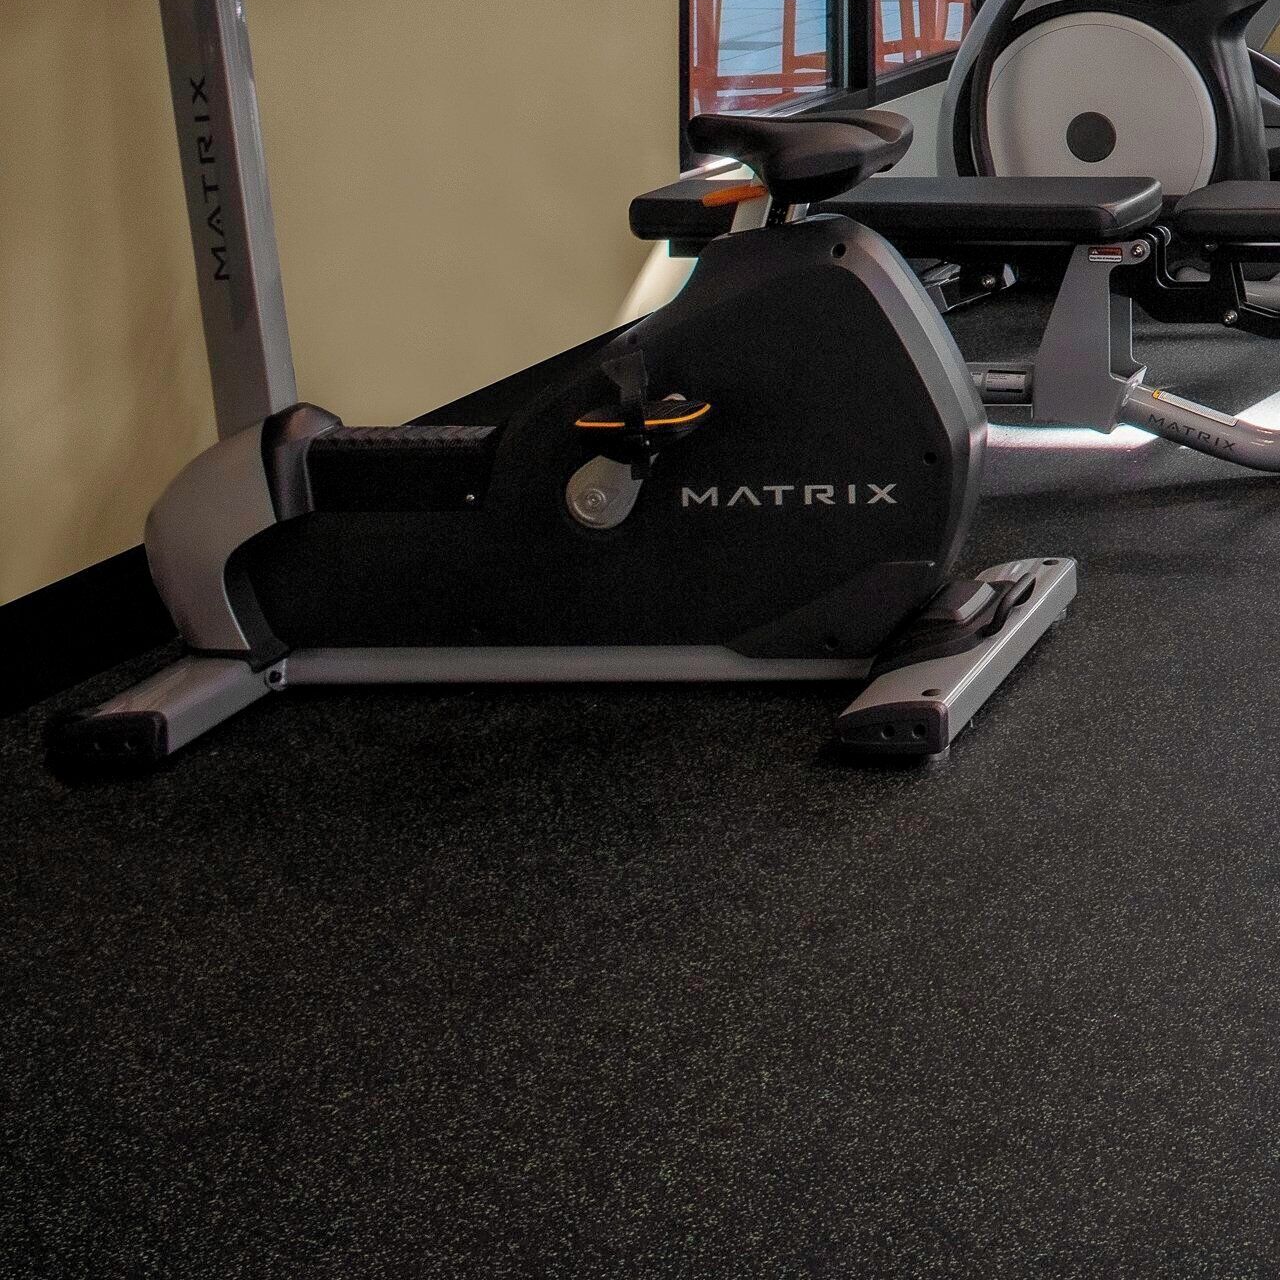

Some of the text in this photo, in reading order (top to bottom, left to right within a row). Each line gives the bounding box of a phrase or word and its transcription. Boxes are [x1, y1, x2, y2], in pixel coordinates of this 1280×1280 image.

[190, 76, 230, 281] MATRIX
[1149, 414, 1236, 451] MATRIX
[681, 483, 899, 508] MATRIX
